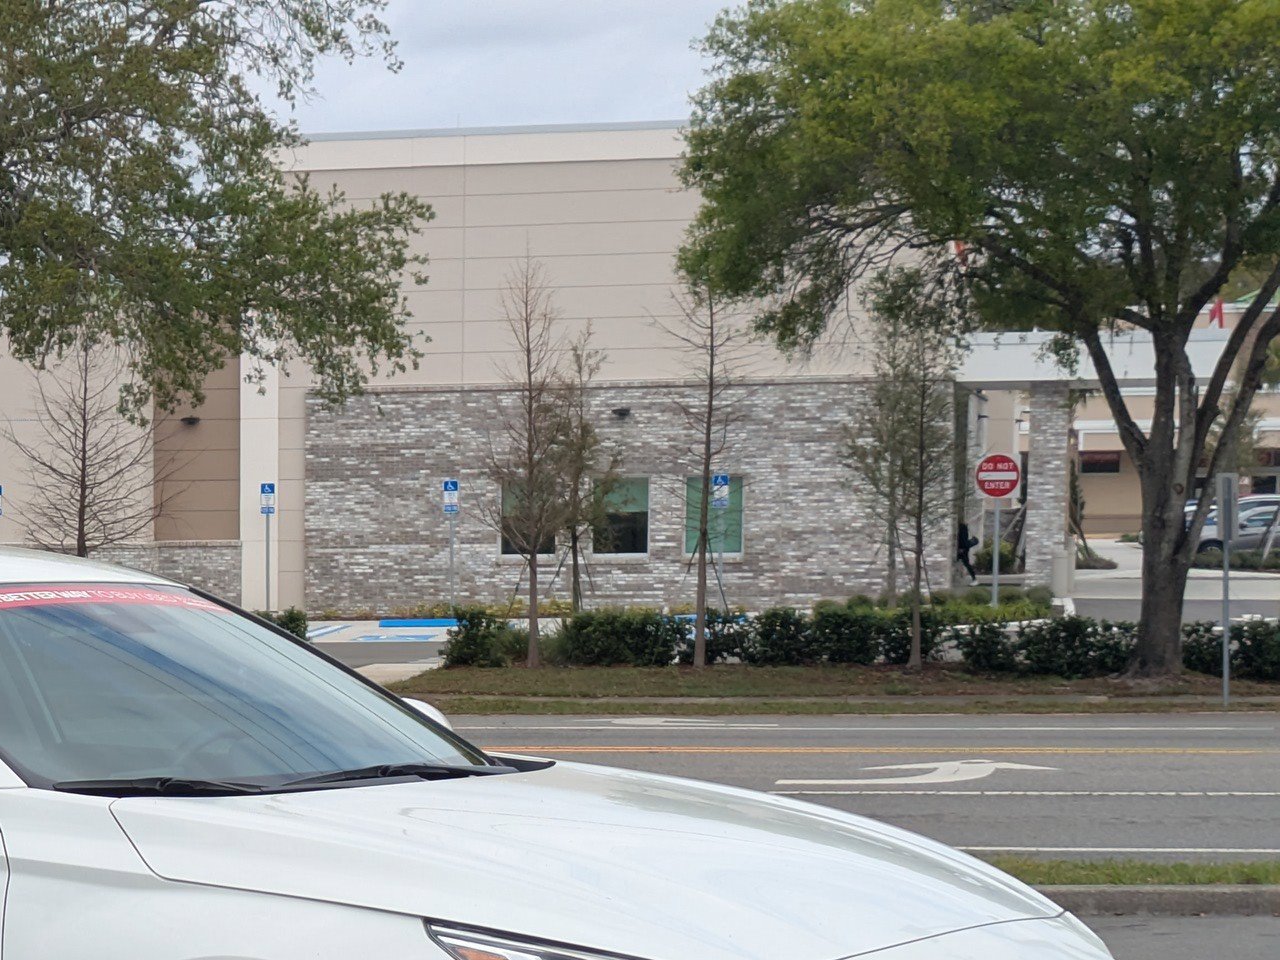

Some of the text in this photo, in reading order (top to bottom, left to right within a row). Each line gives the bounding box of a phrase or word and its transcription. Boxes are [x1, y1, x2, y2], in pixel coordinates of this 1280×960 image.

[982, 462, 1014, 470] DO NOT
[984, 481, 1010, 489] ENTER
